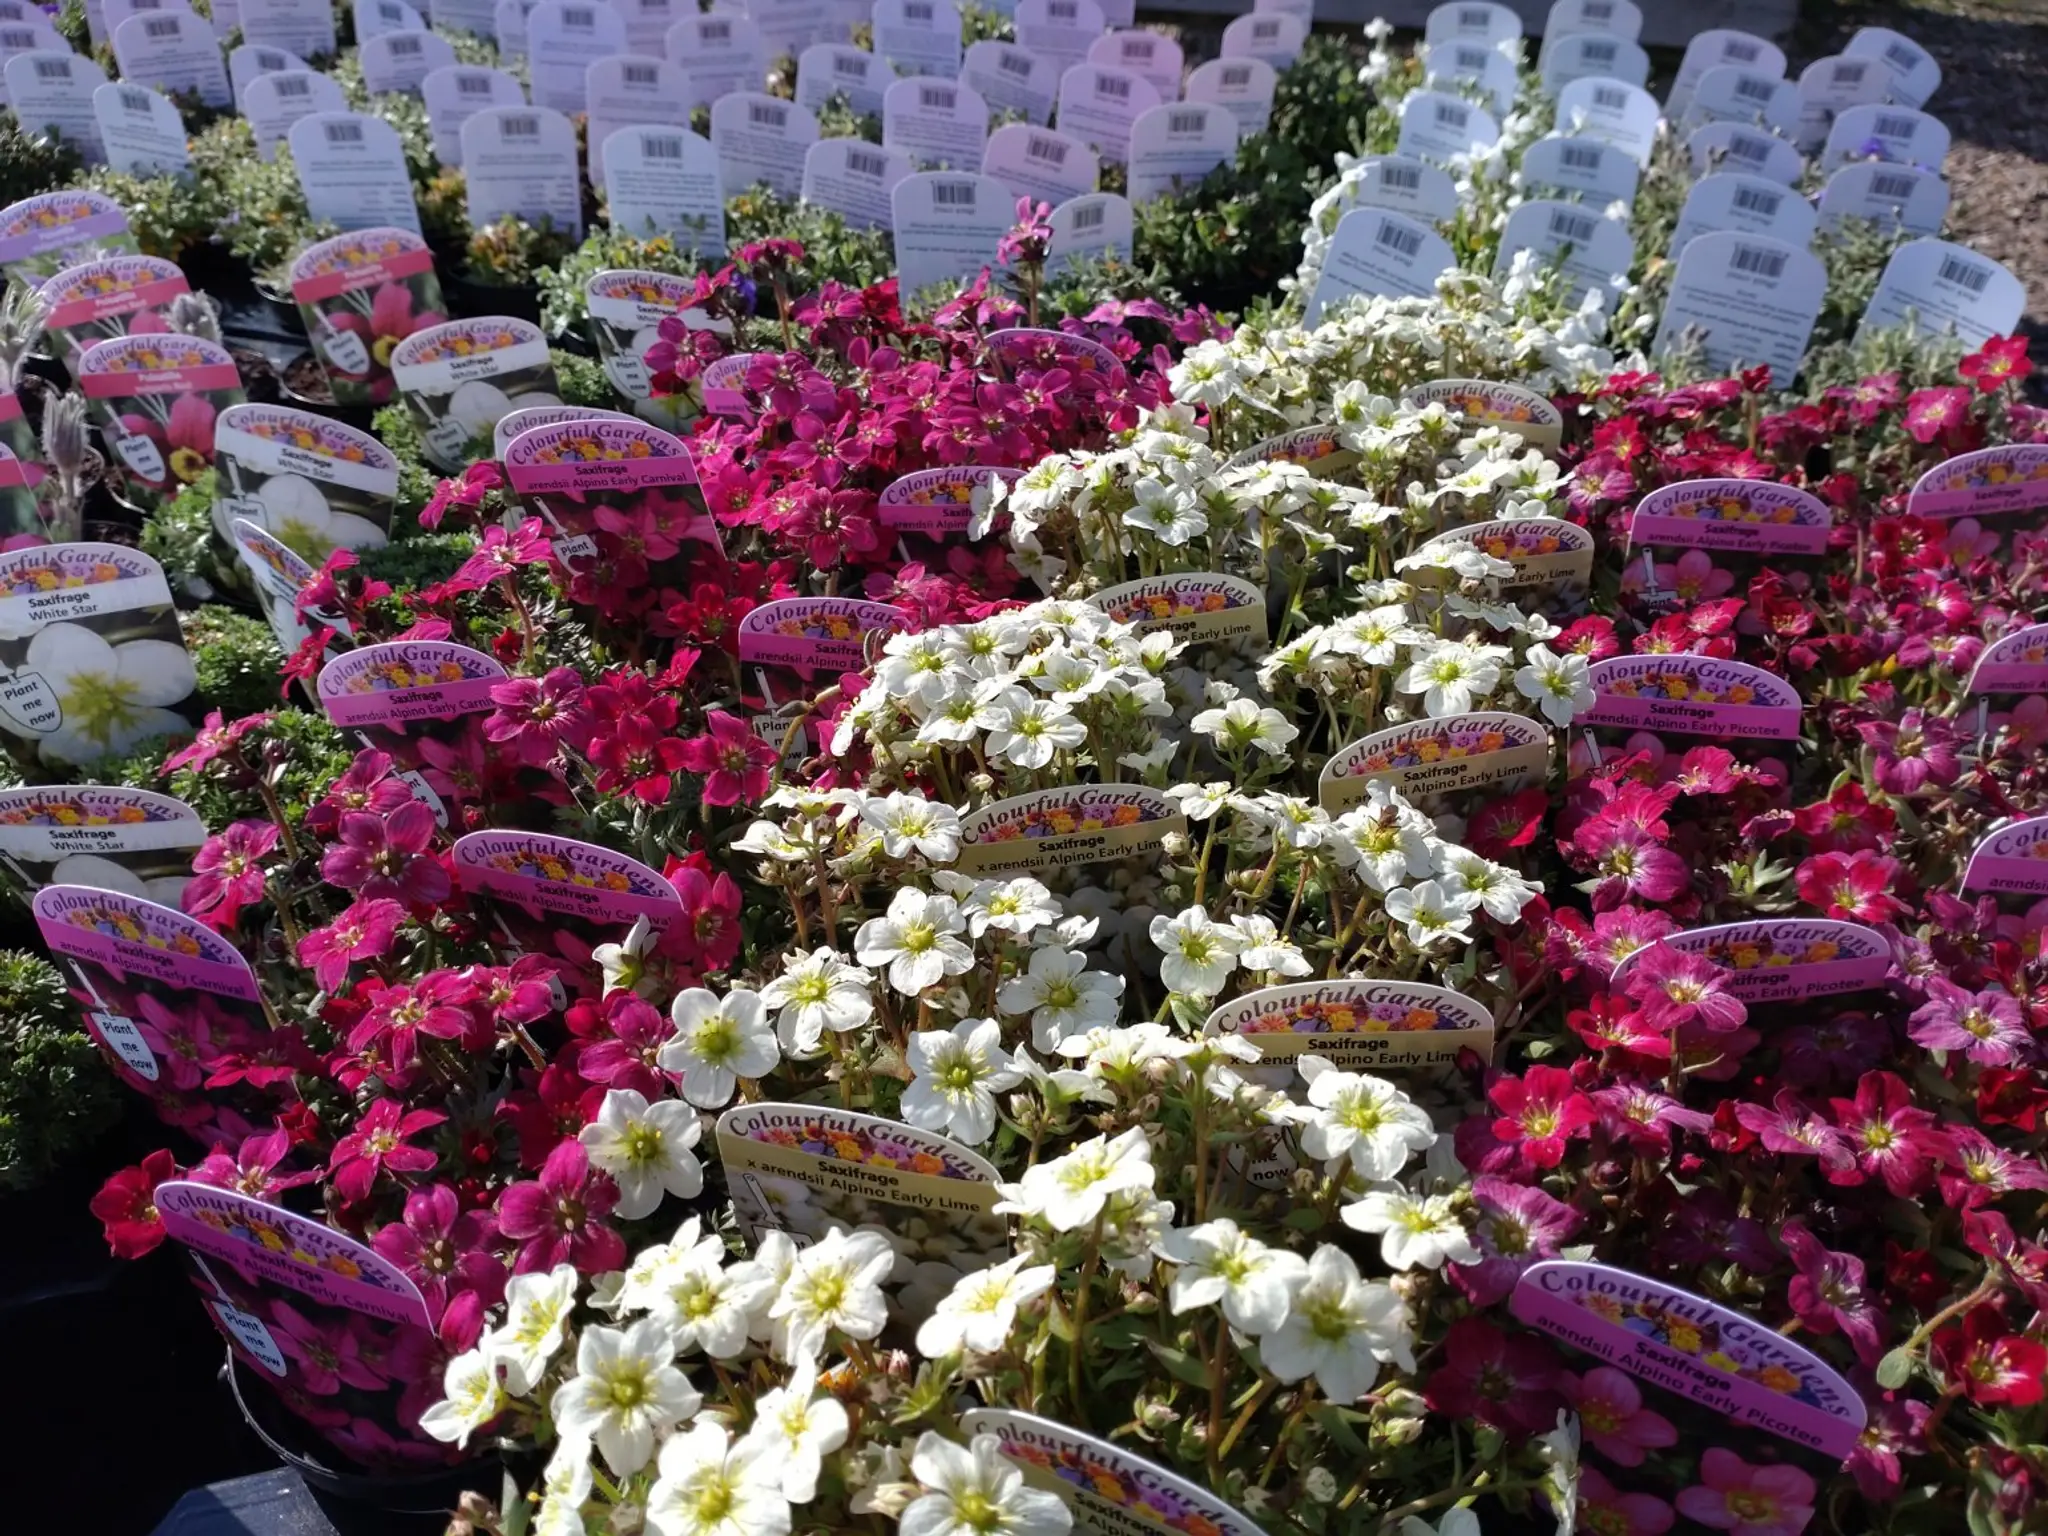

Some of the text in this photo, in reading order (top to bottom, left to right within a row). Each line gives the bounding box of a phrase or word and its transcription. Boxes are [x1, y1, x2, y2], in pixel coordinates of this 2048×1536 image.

[590, 275, 697, 296] Colourful Gard
[85, 337, 226, 374] Colourful Gardens
[397, 321, 536, 367] Colourful Gardens
[450, 356, 493, 369] Saxifrage
[1491, 386, 1555, 424] Gardens
[226, 409, 391, 470] Colourful Gardens
[512, 423, 681, 465] Colourful Gardens
[277, 458, 309, 473] White
[281, 447, 333, 469] Saxifrage
[527, 471, 688, 491] arendsii Alpino Early Carnival
[575, 464, 629, 476] Saxifrage
[1923, 451, 2011, 493] Colourful
[886, 469, 970, 505] Colourful
[1647, 483, 1826, 526] Colourful Gardens
[936, 521, 968, 532] Alpin
[1514, 519, 1587, 550] Gardens
[1703, 523, 1760, 538] Saxifrage
[560, 541, 589, 556] Plant
[1737, 538, 1767, 551] Early
[56, 548, 152, 577] Gardens
[1518, 568, 1576, 584] Early Lime
[28, 591, 91, 609] Saxifrage
[1099, 578, 1257, 613] lourful Gardens
[29, 603, 98, 621] White Star
[749, 600, 851, 633] Colourful
[1191, 622, 1252, 642] Early Lime
[753, 651, 847, 669] arendsii Alpino
[815, 643, 864, 658] Saxifrag
[323, 645, 495, 697] Colourful Gardens
[1596, 658, 1791, 707] olourful Gardens
[4, 681, 40, 701] Plant
[389, 690, 444, 705] Saxifrage
[22, 698, 43, 712] me
[345, 709, 388, 723] arendsii
[390, 704, 427, 720] Alpino
[428, 701, 457, 715] Early
[1650, 703, 1716, 718] Saxifrage
[29, 710, 57, 726] now
[762, 721, 789, 732] Plan
[1587, 712, 1781, 736] arendsii Alpino Early Picotee
[1332, 717, 1538, 780] Colourful Gardens
[1342, 763, 1529, 805] x Alpino Early Lime
[1403, 763, 1468, 782] Saxifrage
[77, 789, 185, 821] Gardens
[962, 789, 1177, 846] Colourful Gardens
[49, 829, 117, 840] Saxifrage
[50, 840, 125, 851] White Star
[1038, 836, 1106, 853] Saxifrage
[461, 837, 669, 898] Colourful Gardens
[976, 840, 1162, 873] x arendsii Alpino Early Lim
[535, 882, 600, 903] Saxifrage
[531, 894, 612, 920] Alpino Early
[41, 893, 237, 965] Colourful Gardens
[1772, 923, 1880, 958] Gardens
[112, 942, 175, 967] Saxifrage
[59, 940, 246, 997] arendsii Alpino Early Carnival
[1761, 984, 1802, 1000] Early
[1806, 977, 1865, 995] Picotee
[1218, 985, 1482, 1033] Colourful Gardens
[103, 1021, 133, 1036] Plant
[121, 1041, 138, 1052] me
[1308, 1038, 1390, 1051] Saxifrage
[130, 1058, 154, 1071] now
[1230, 1050, 1456, 1069] x lpino Early Lim
[729, 1111, 991, 1184] Colourful Gardens
[818, 1160, 900, 1187] Saxifrage
[1253, 1168, 1289, 1181] now
[746, 1159, 982, 1213] x arendsii Alpino Early Lime
[161, 1190, 406, 1294] Colourful Gardens
[247, 1247, 325, 1284] Saxifrage
[181, 1234, 411, 1325] arendsii Alpino Early Carnival
[224, 1311, 261, 1334] Plant
[245, 1334, 266, 1350] me
[1539, 1270, 1852, 1418] Colourful Gardens
[253, 1351, 281, 1369] now
[1635, 1341, 1732, 1392] Saxifrage
[1535, 1315, 1824, 1448] arendsii Alpino Early Picotee
